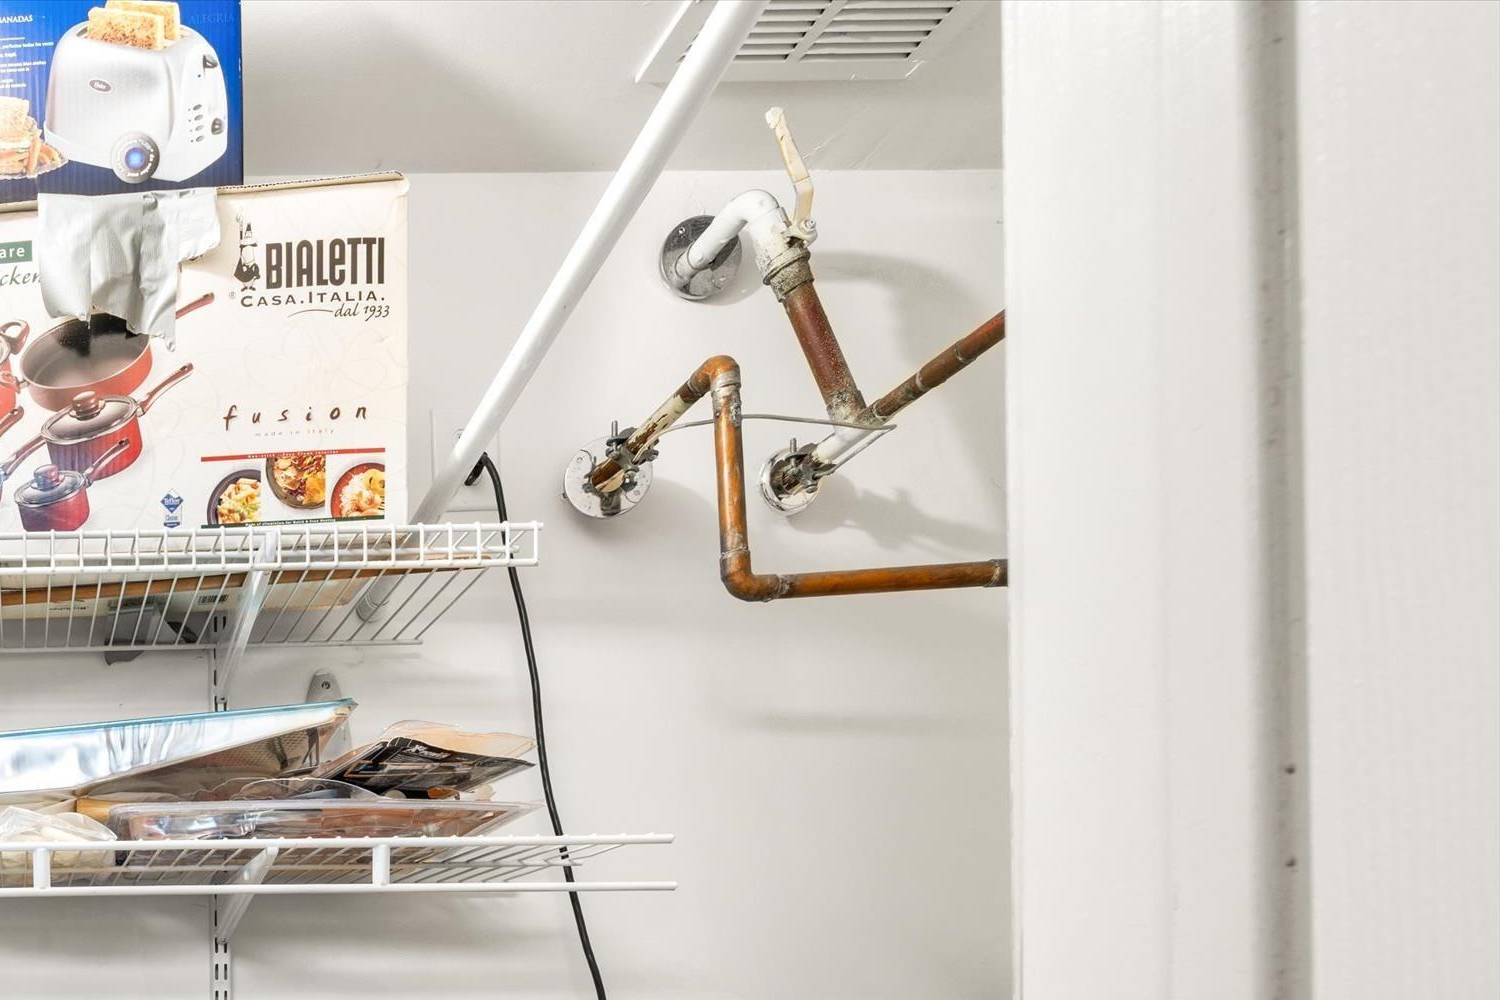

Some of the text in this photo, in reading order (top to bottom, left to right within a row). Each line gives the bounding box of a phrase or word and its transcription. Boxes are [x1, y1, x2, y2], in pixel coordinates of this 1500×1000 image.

[334, 302, 390, 322] dal 1933
[222, 404, 368, 432] fusion
